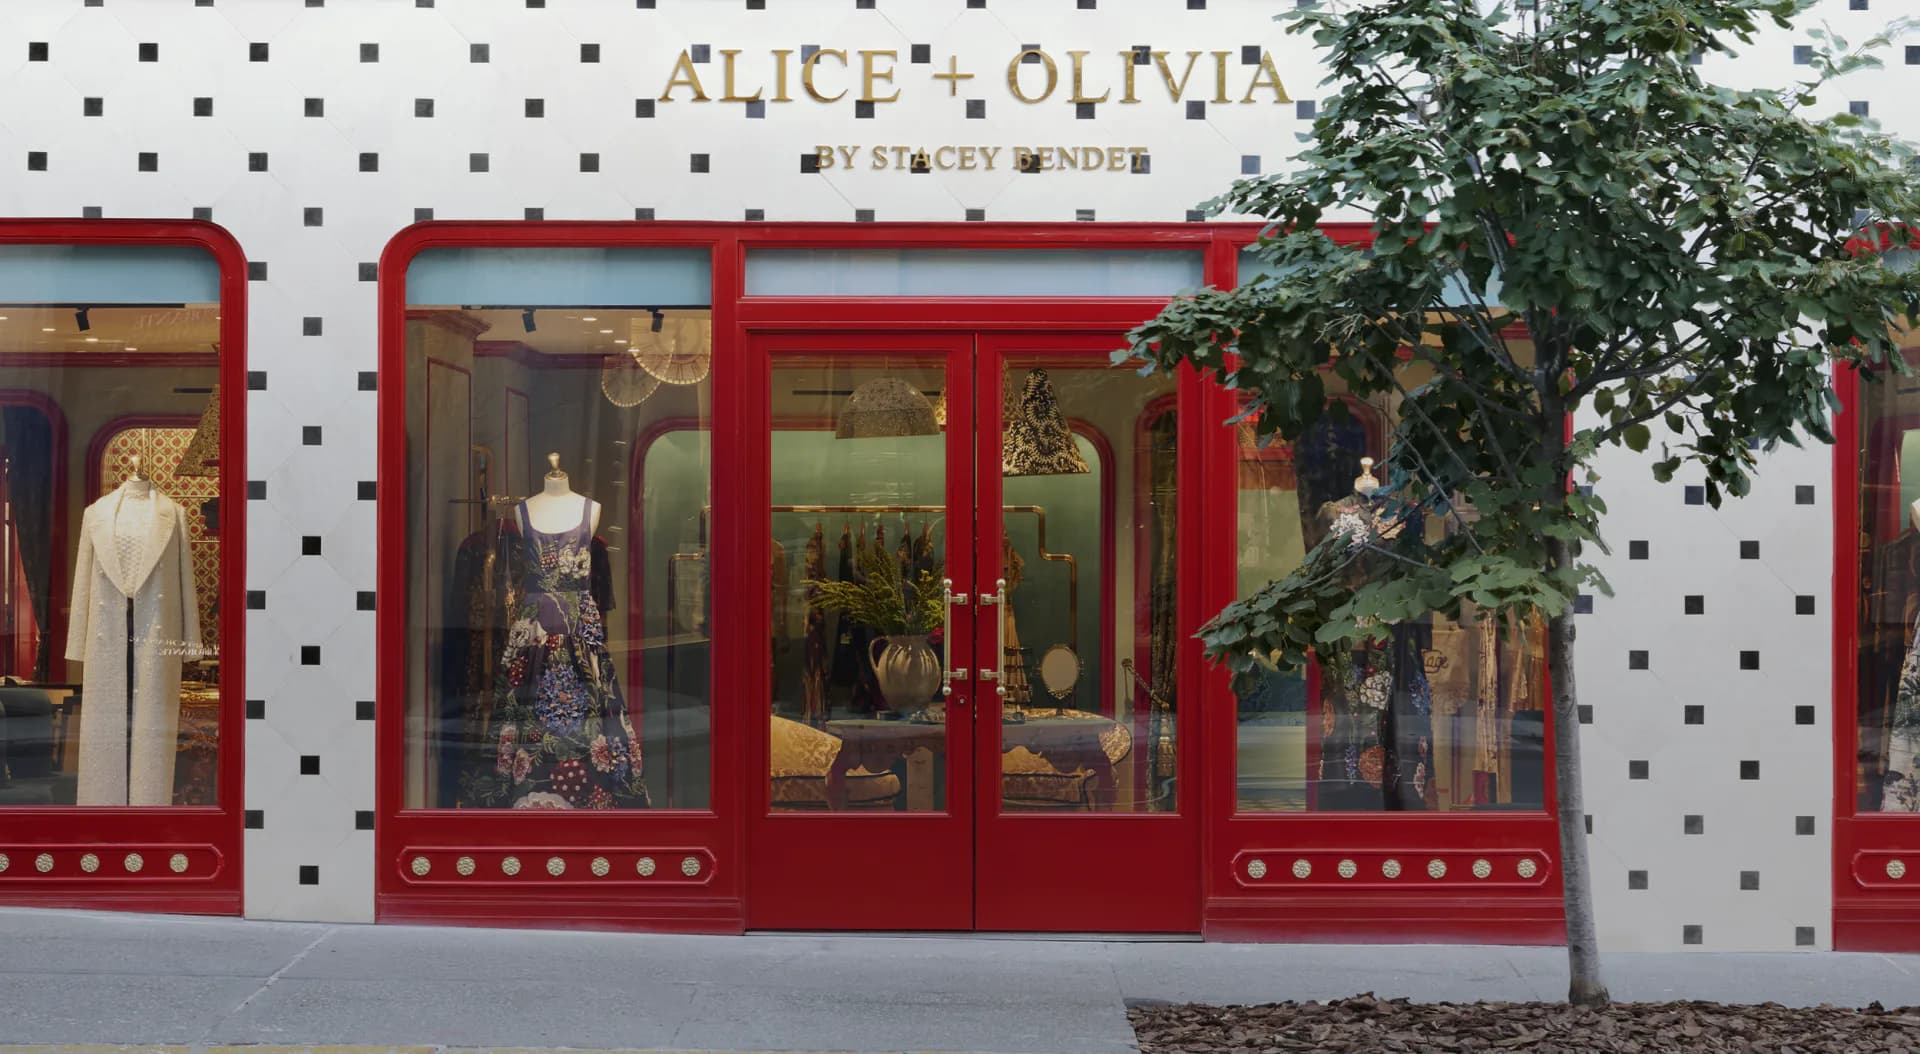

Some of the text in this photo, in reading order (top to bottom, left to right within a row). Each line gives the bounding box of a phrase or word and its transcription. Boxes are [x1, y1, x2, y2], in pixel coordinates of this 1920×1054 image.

[658, 48, 1294, 104] ALICE + OLIVIA
[815, 145, 1148, 171] BY STACEY BENDET
